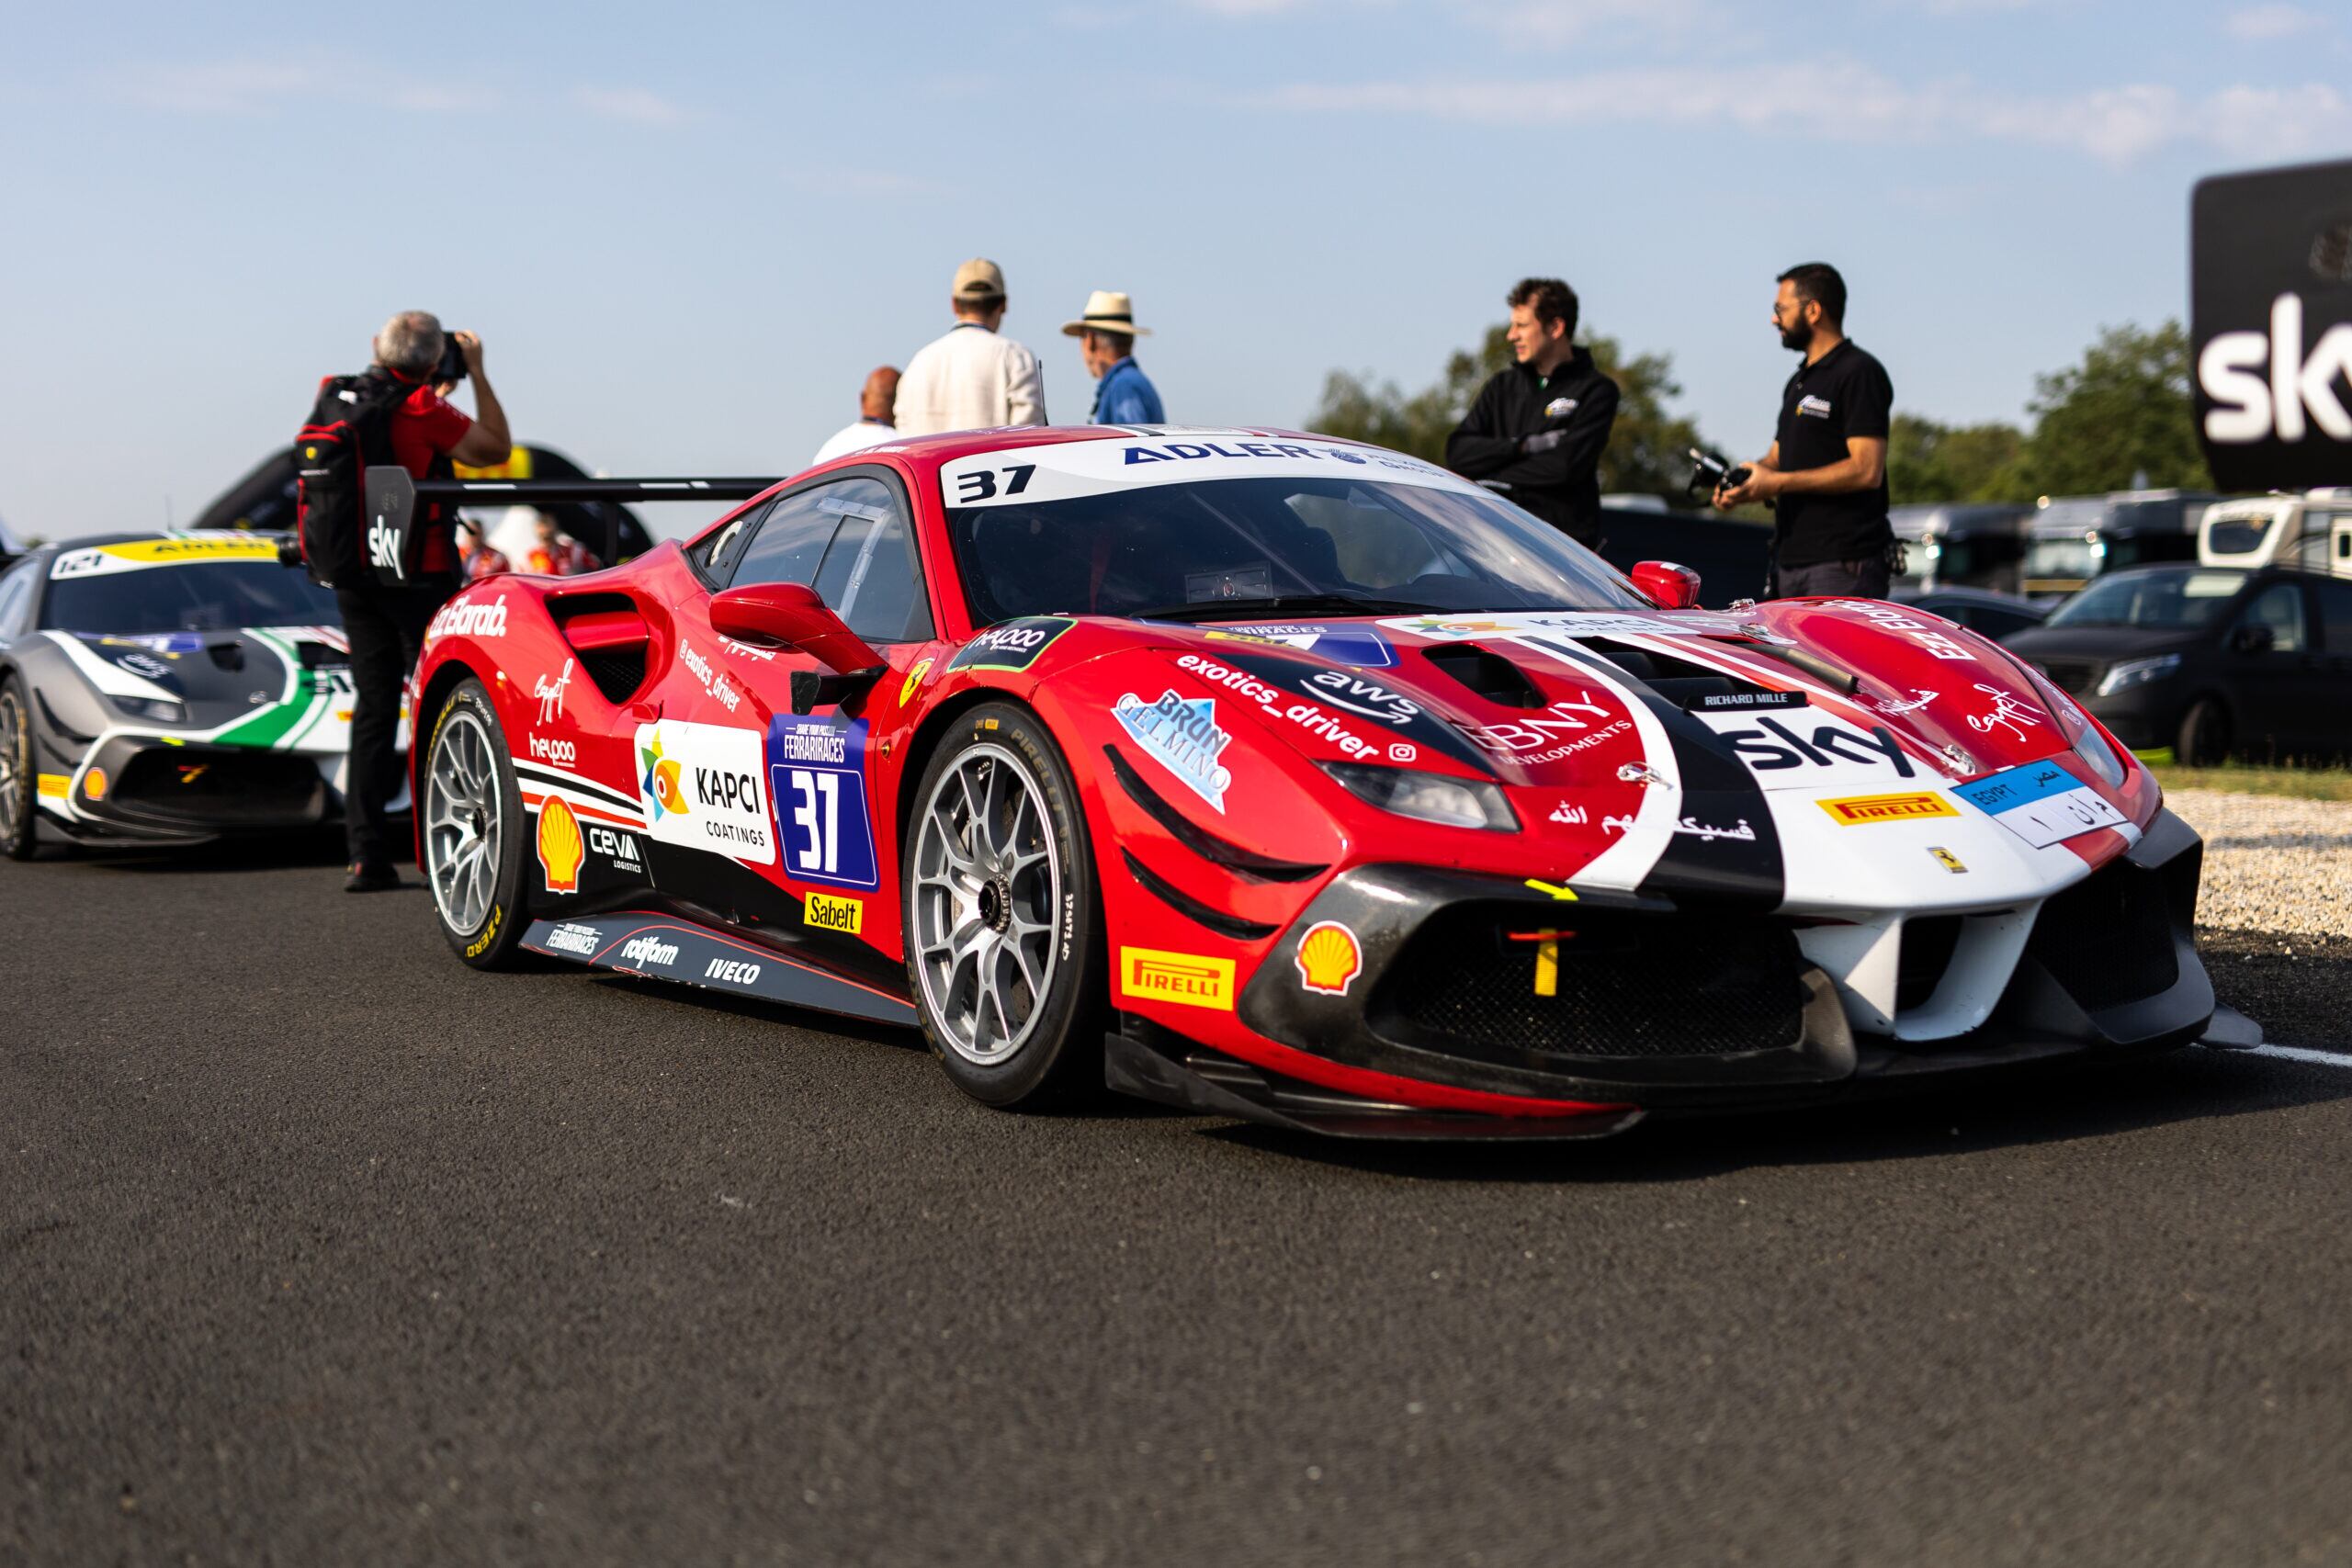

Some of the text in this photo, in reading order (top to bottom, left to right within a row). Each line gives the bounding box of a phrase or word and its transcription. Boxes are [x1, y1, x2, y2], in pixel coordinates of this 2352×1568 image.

[2199, 292, 2352, 445] sk
[1122, 443, 1324, 466] ADLER
[957, 464, 1036, 503] 37
[368, 514, 404, 580] sky
[684, 649, 741, 713] exotics_driver
[1312, 670, 1421, 718] aws
[1704, 693, 1788, 705] RICHARD MILLE
[1154, 691, 1229, 757] BRUN
[1177, 653, 1379, 761] exotics_driver
[784, 734, 845, 763] FERRARIRACES
[1498, 718, 1633, 767] DEVELOPMENTS
[1718, 716, 1916, 778] sky
[695, 766, 762, 815] KAPCI
[1972, 784, 2018, 806] EGYPT
[2033, 771, 2062, 788] مصر
[790, 770, 840, 874] 37
[1548, 799, 1589, 825] الله
[1833, 796, 1944, 818] PIRELLI
[706, 820, 766, 847] COATINGS
[613, 859, 642, 874] LOGISTICS
[809, 896, 857, 931] Sabelt
[467, 919, 496, 958] ZERO
[705, 958, 762, 986] IVECO
[1133, 958, 1221, 998] PIRELLI
